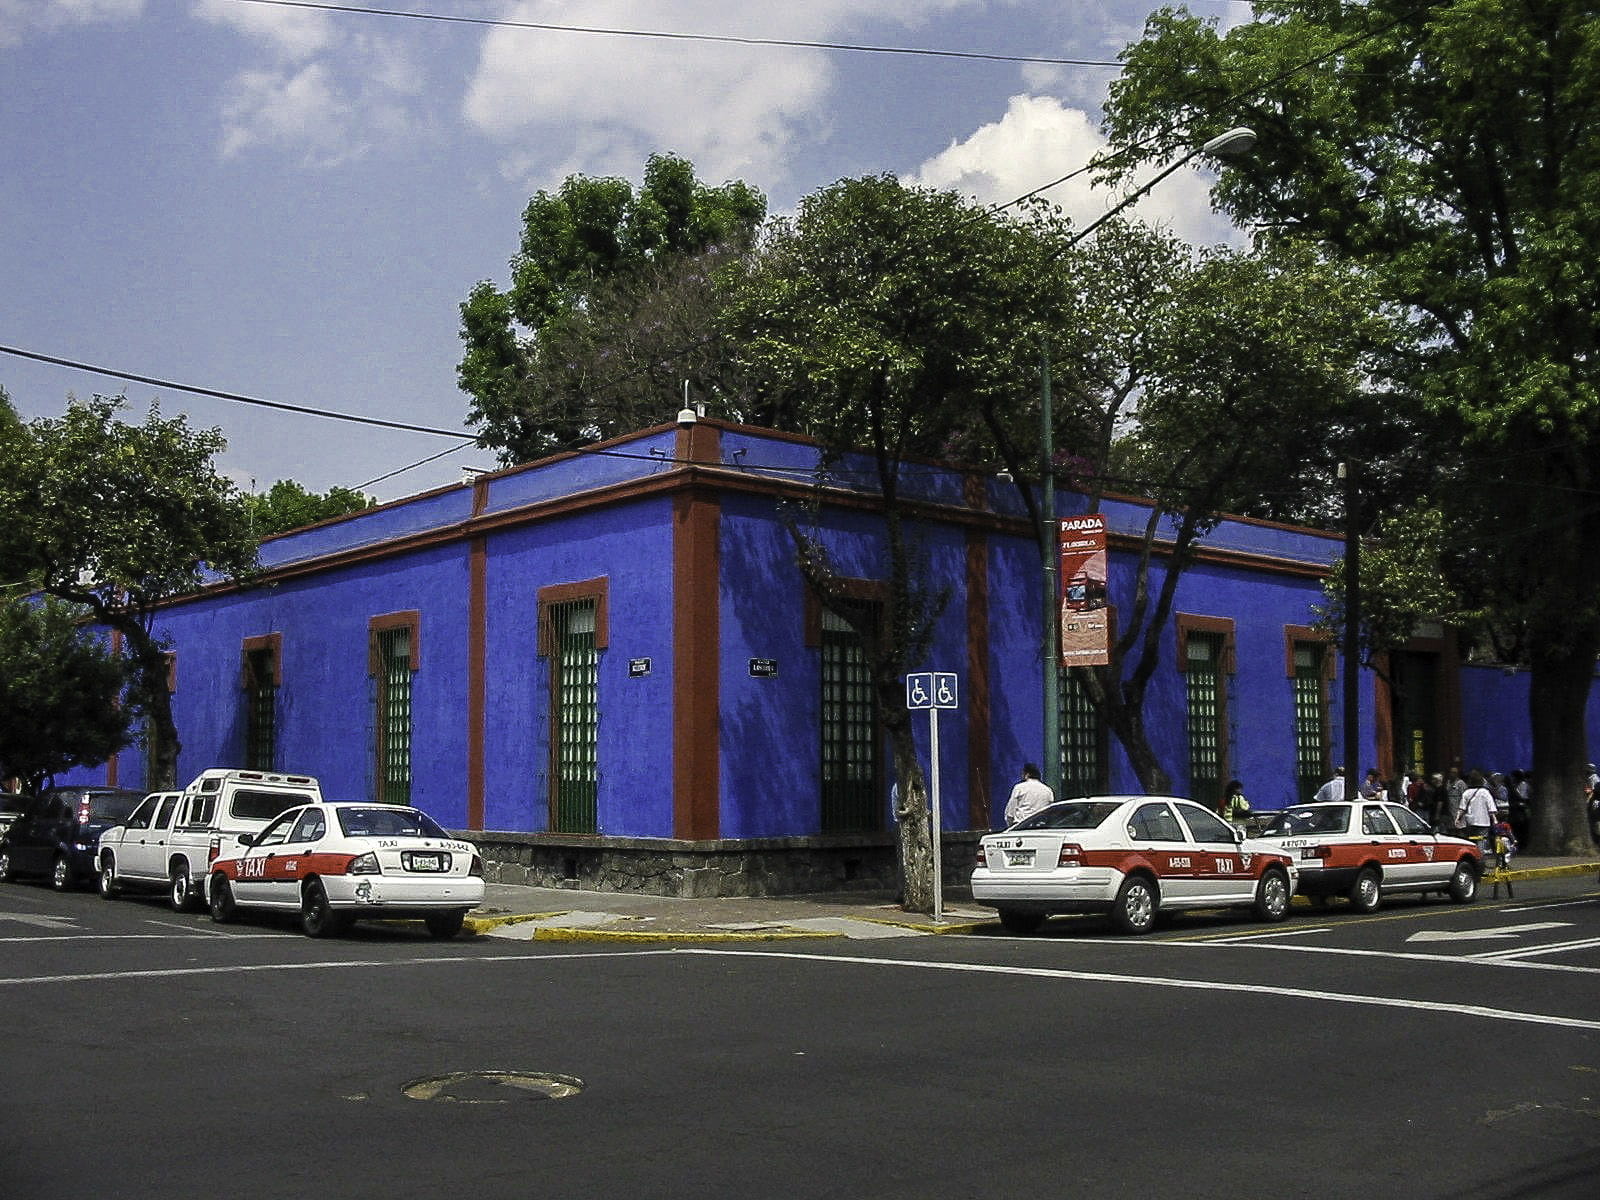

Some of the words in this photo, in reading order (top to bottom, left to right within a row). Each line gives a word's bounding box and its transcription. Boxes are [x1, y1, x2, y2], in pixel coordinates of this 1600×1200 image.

[1061, 518, 1104, 531] PARADA
[378, 840, 398, 848] TAXI
[245, 858, 267, 877] TAXI
[1214, 858, 1234, 873] TAXI
